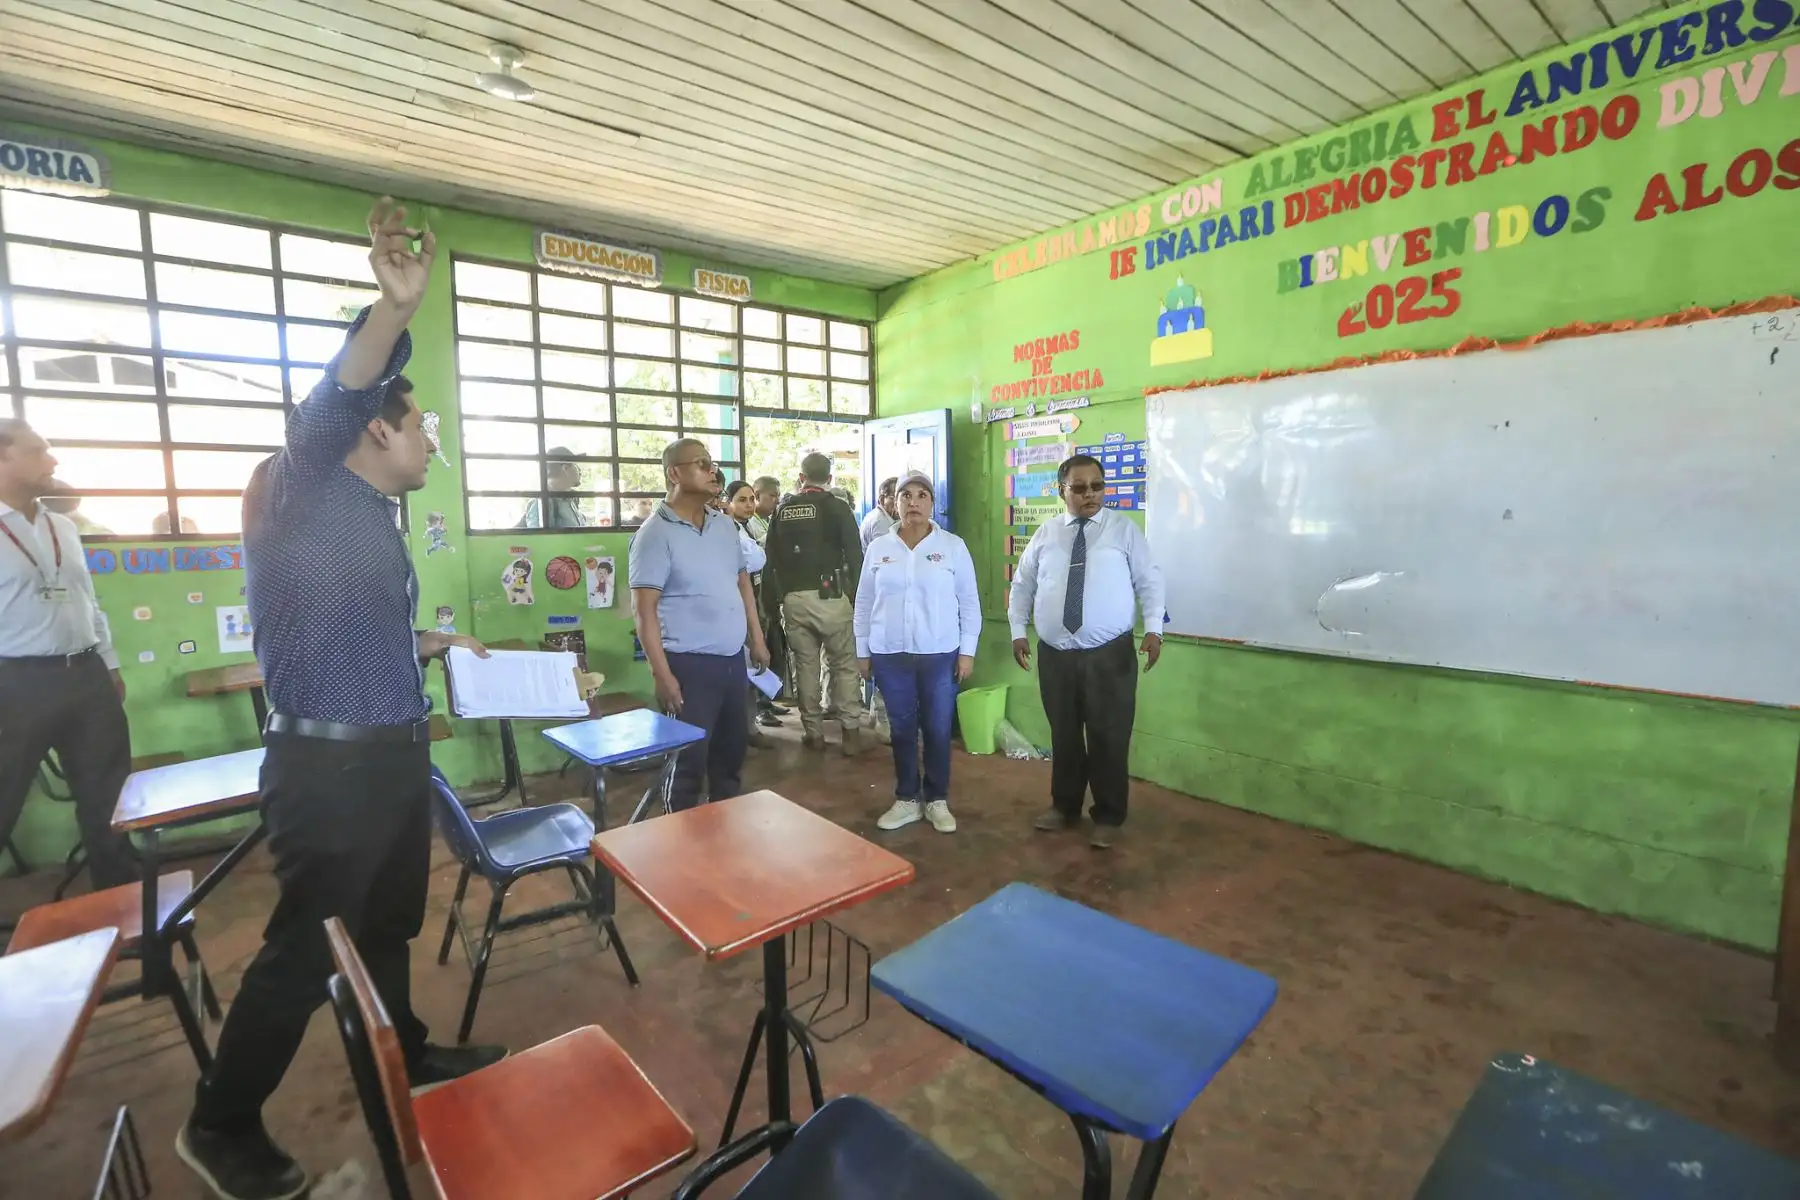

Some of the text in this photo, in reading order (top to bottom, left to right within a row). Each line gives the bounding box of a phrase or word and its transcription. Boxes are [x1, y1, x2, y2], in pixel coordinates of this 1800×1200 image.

[1162, 178, 1223, 224] CON
[1244, 116, 1420, 198] ALEGRIA
[1431, 89, 1497, 142] EL
[1504, 0, 1800, 117] ANIVERS
[1109, 246, 1137, 280] IE
[1145, 200, 1274, 270] IÑAPARI
[1284, 95, 1640, 229] DEMOSTRANDO
[1276, 186, 1612, 294] BIENVENIDOS
[698, 270, 749, 297] FISICA
[1337, 268, 1462, 338] 2025
[1013, 329, 1080, 363] NORMAS
[1031, 356, 1053, 377] DE
[991, 367, 1104, 403] CONVIVENCIA
[783, 507, 815, 519] ESCOLTA
[122, 548, 170, 575] UN
